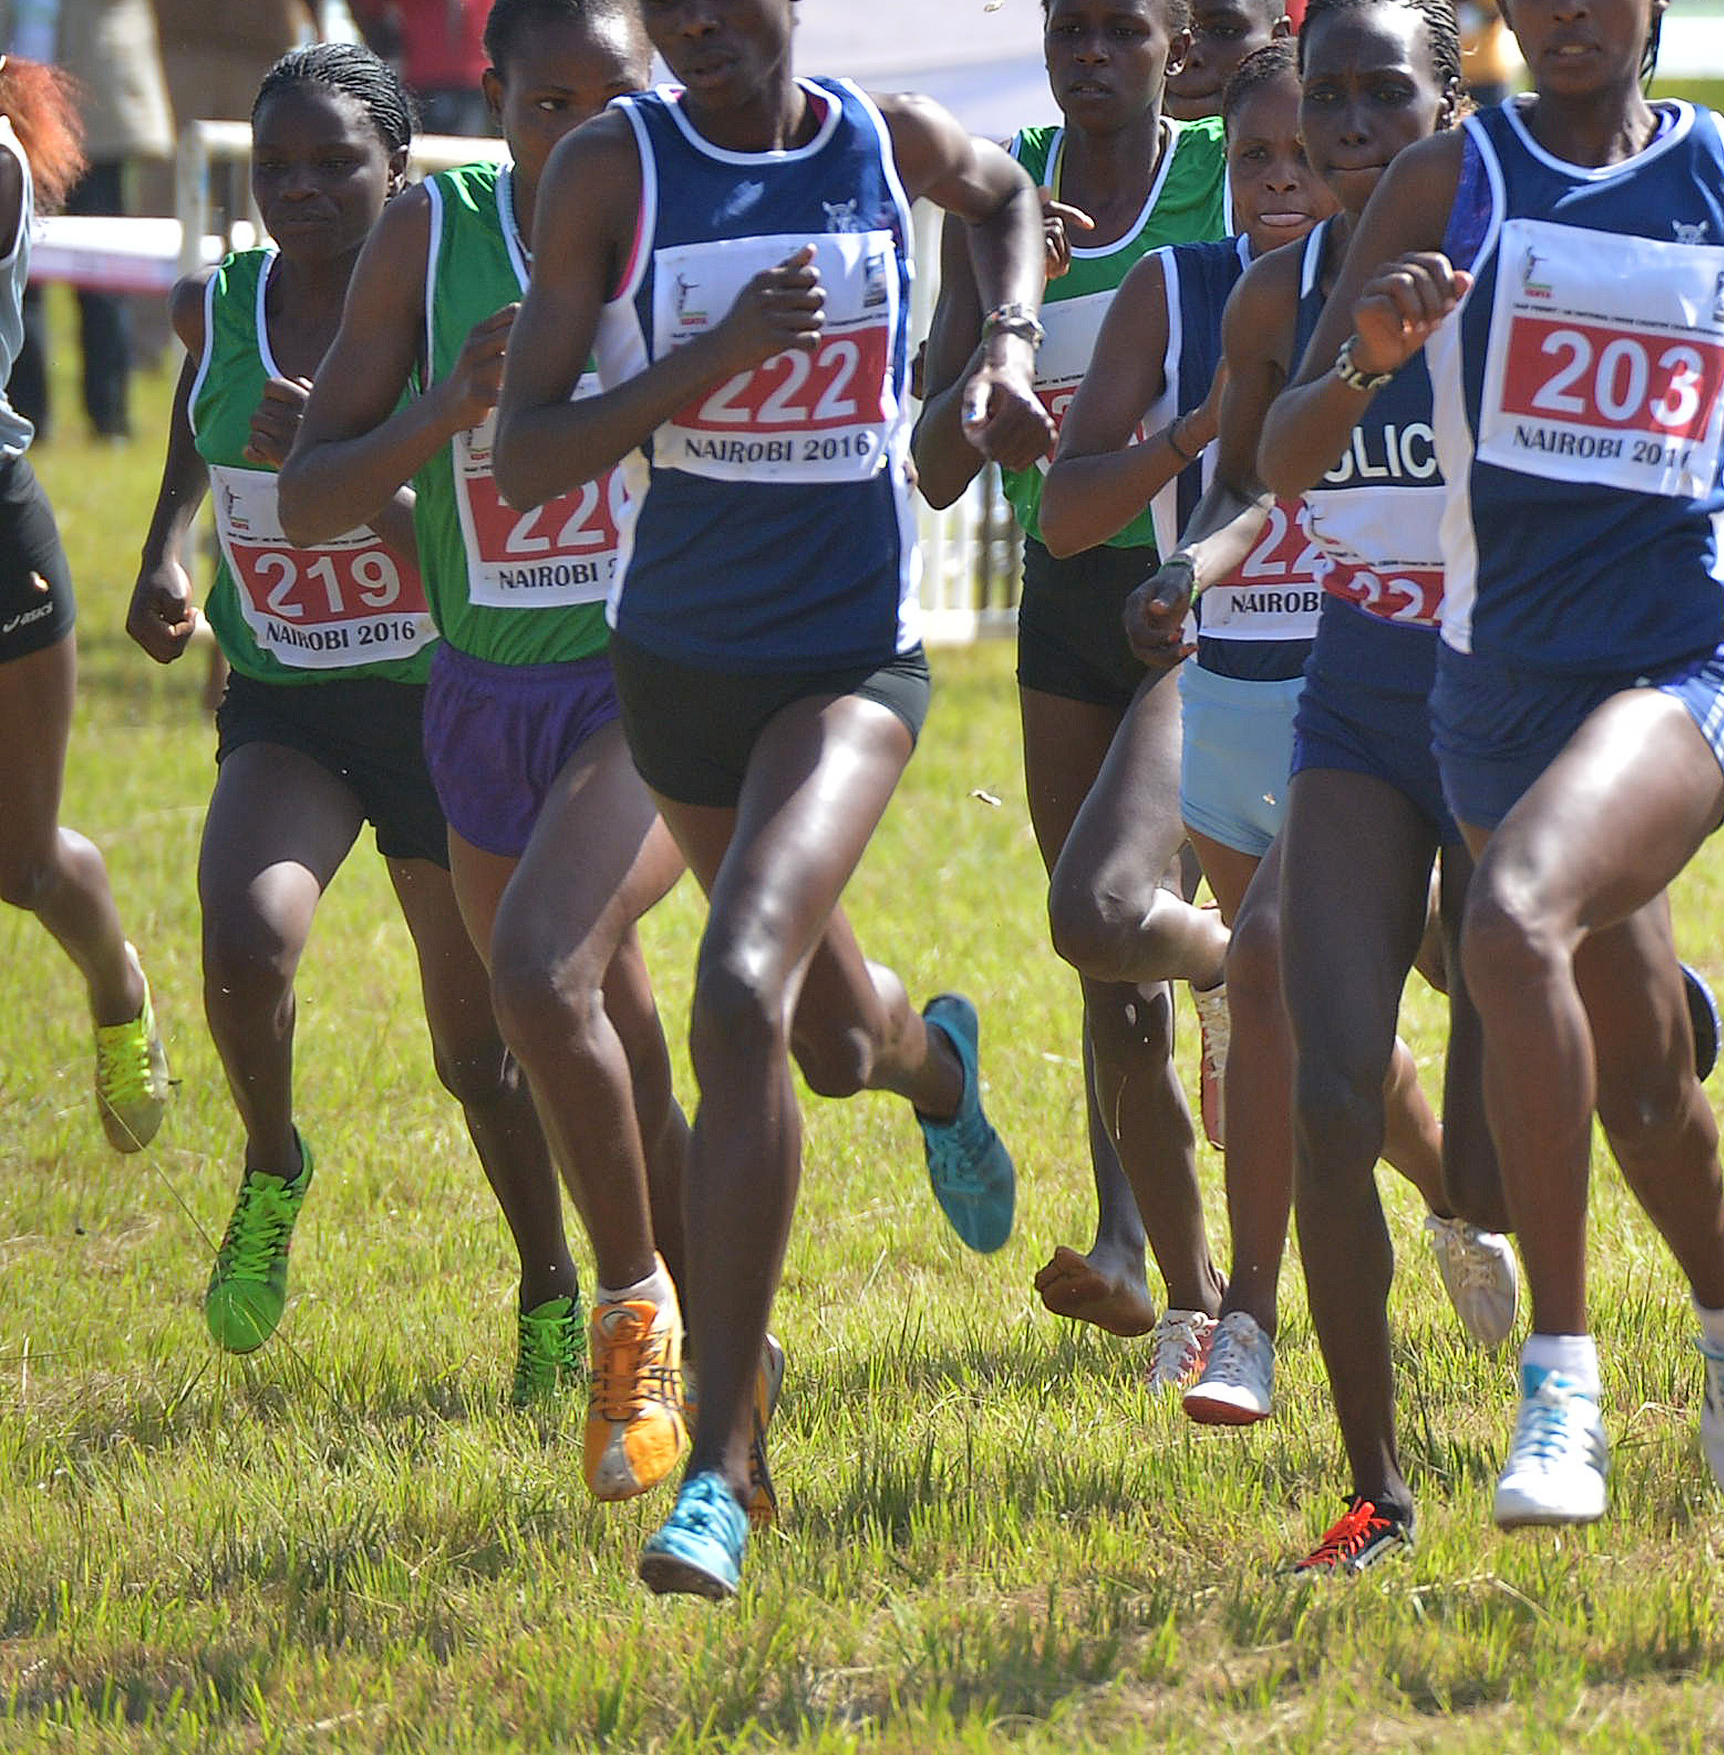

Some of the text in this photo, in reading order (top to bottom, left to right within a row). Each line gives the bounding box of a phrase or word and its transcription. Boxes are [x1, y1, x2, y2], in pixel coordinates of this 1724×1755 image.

[697, 339, 860, 424] 222
[1531, 329, 1705, 427] 203
[684, 432, 870, 464] NAIROBI 2016
[1323, 421, 1437, 483] LIC
[1513, 424, 1625, 459] NAIROBI
[255, 551, 401, 617] 219
[498, 562, 599, 590] NAIROBI
[266, 620, 416, 651] NAIROBI 2016
